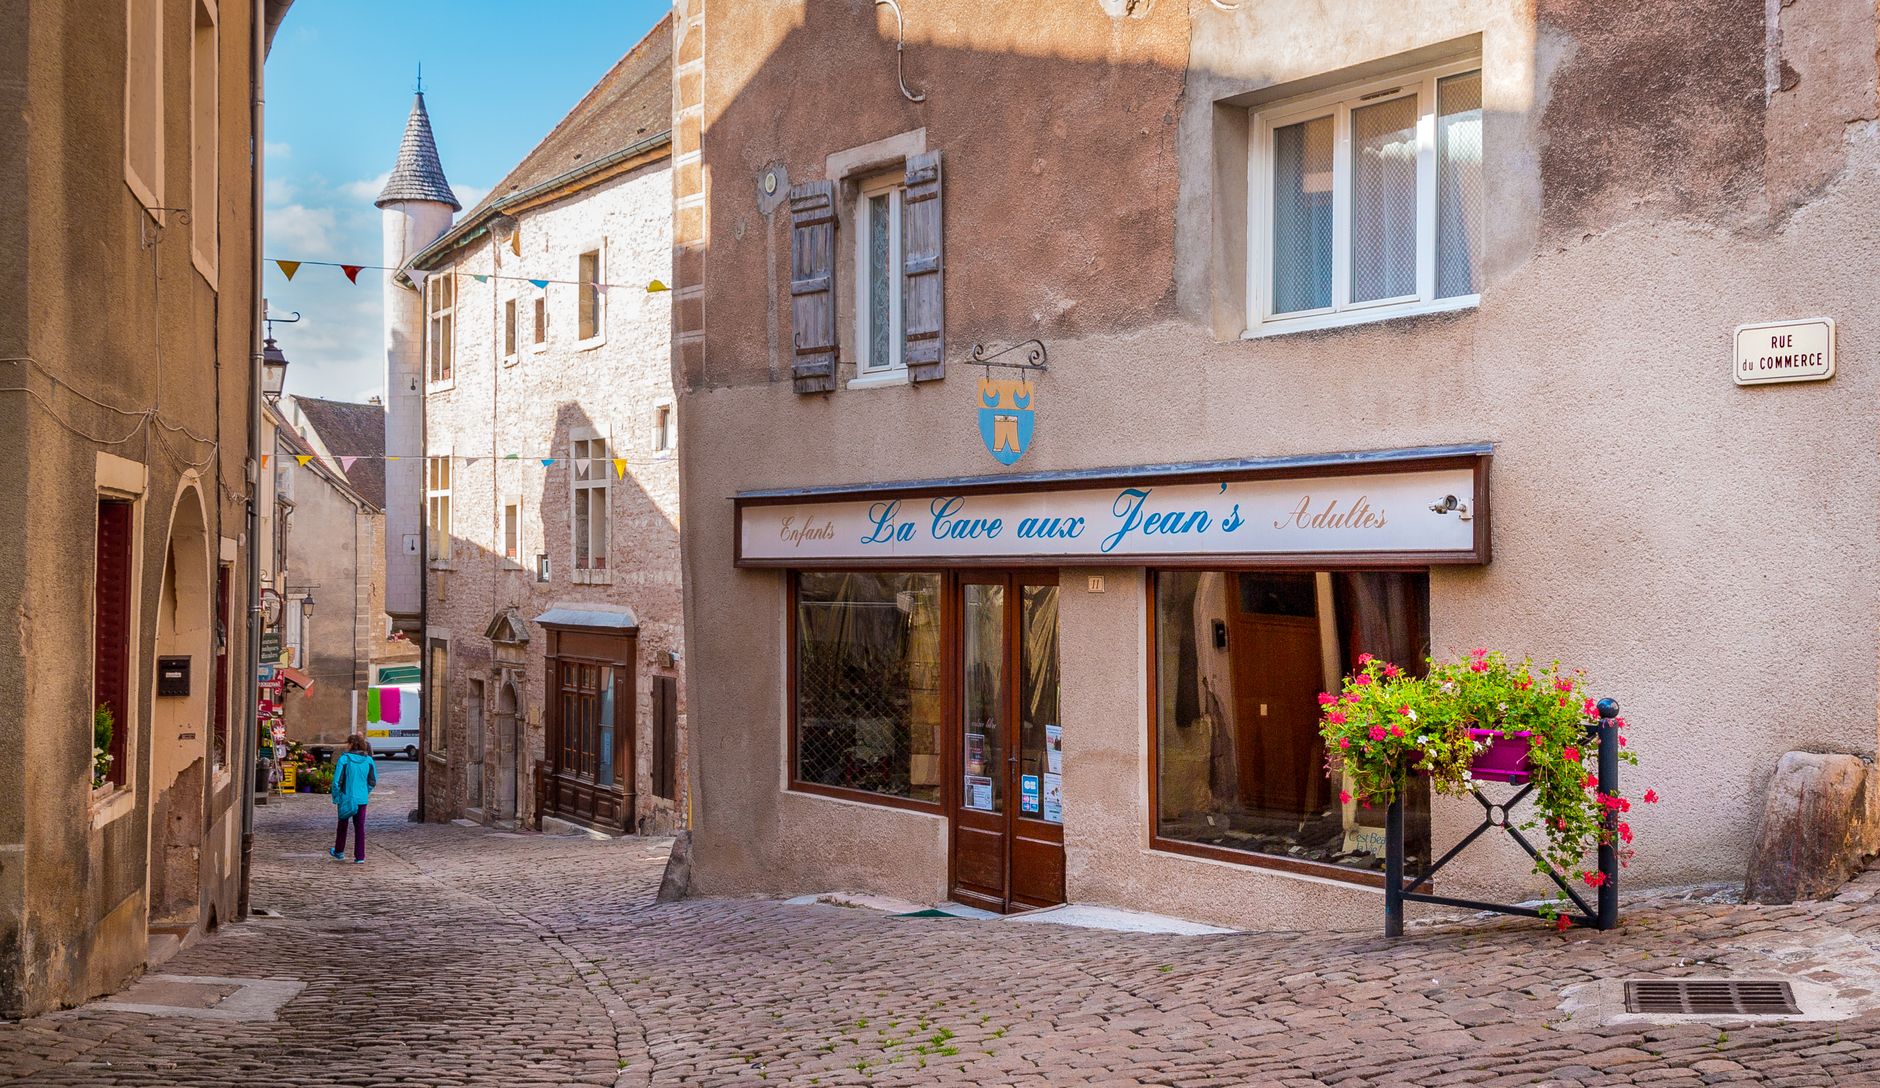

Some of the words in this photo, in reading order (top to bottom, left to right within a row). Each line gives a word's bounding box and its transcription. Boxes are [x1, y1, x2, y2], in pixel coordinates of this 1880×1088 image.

[1771, 335, 1792, 349] RUE
[1742, 359, 1754, 371] du
[1759, 353, 1822, 370] COMMERCE
[860, 498, 917, 544] La
[929, 495, 1003, 540] Cave
[1016, 513, 1086, 539] aux
[1100, 482, 1245, 553] Jean's
[1273, 495, 1390, 530] Adultes
[780, 513, 834, 547] Enfants
